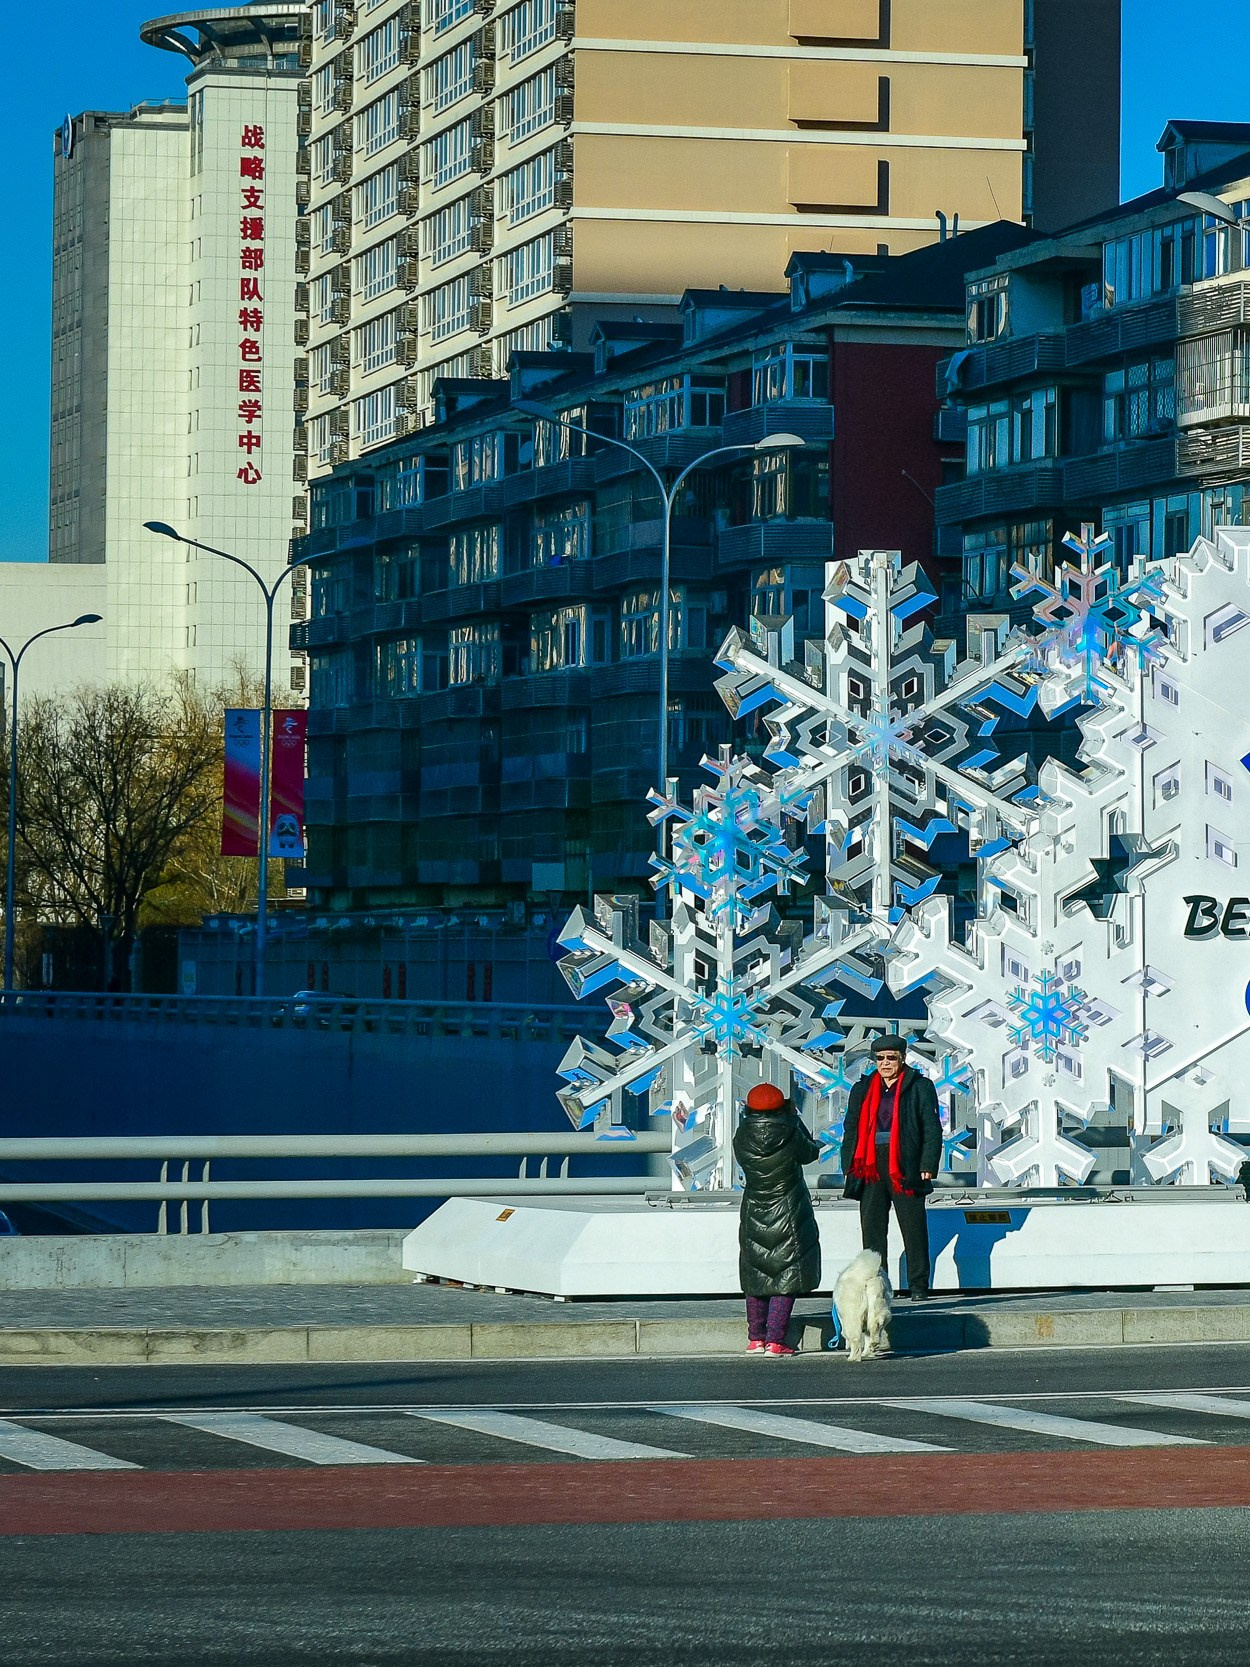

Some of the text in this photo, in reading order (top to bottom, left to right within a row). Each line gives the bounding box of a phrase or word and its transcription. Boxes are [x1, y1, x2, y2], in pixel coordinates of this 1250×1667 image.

[237, 124, 266, 486] 战略支援部队特色医学中心
